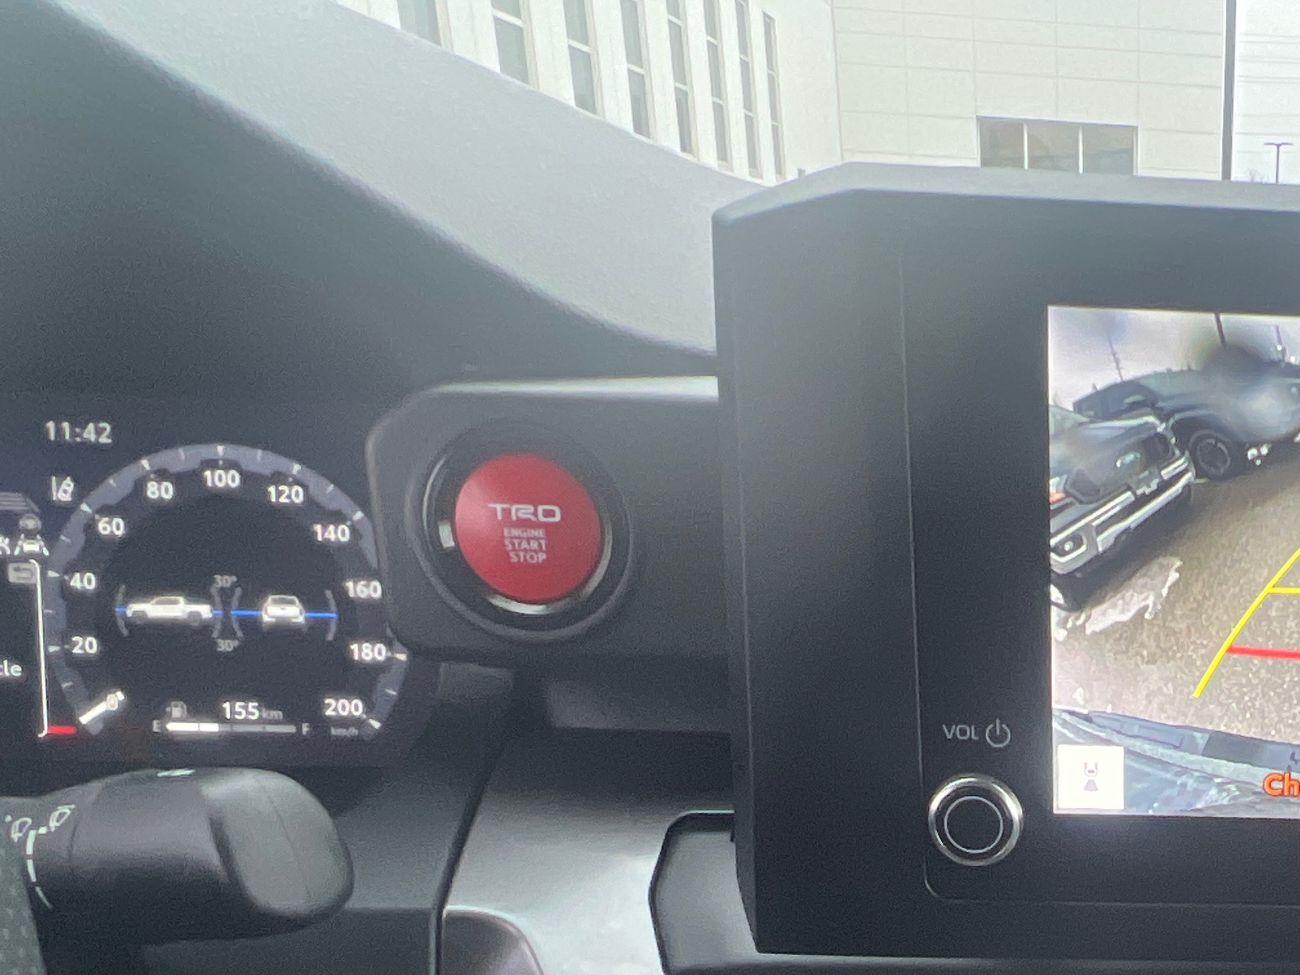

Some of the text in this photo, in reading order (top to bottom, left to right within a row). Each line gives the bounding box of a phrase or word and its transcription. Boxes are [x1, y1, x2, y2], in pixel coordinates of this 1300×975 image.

[45, 421, 113, 444] 11:42
[203, 469, 241, 489] 100
[146, 481, 174, 500] 80
[267, 485, 304, 504] 120
[488, 503, 561, 522] TRD
[99, 517, 126, 537] 60
[313, 524, 350, 543] 140
[504, 527, 545, 537] ENGINE
[504, 539, 547, 551] START
[509, 551, 546, 563] STOP
[70, 572, 96, 590] 40
[345, 579, 383, 599] 160
[71, 636, 98, 654] 20
[349, 642, 386, 661] 180
[222, 701, 284, 720] 155 km
[324, 698, 364, 717] 200
[152, 720, 162, 733] E
[302, 722, 311, 736] F
[943, 723, 980, 740] VOL
